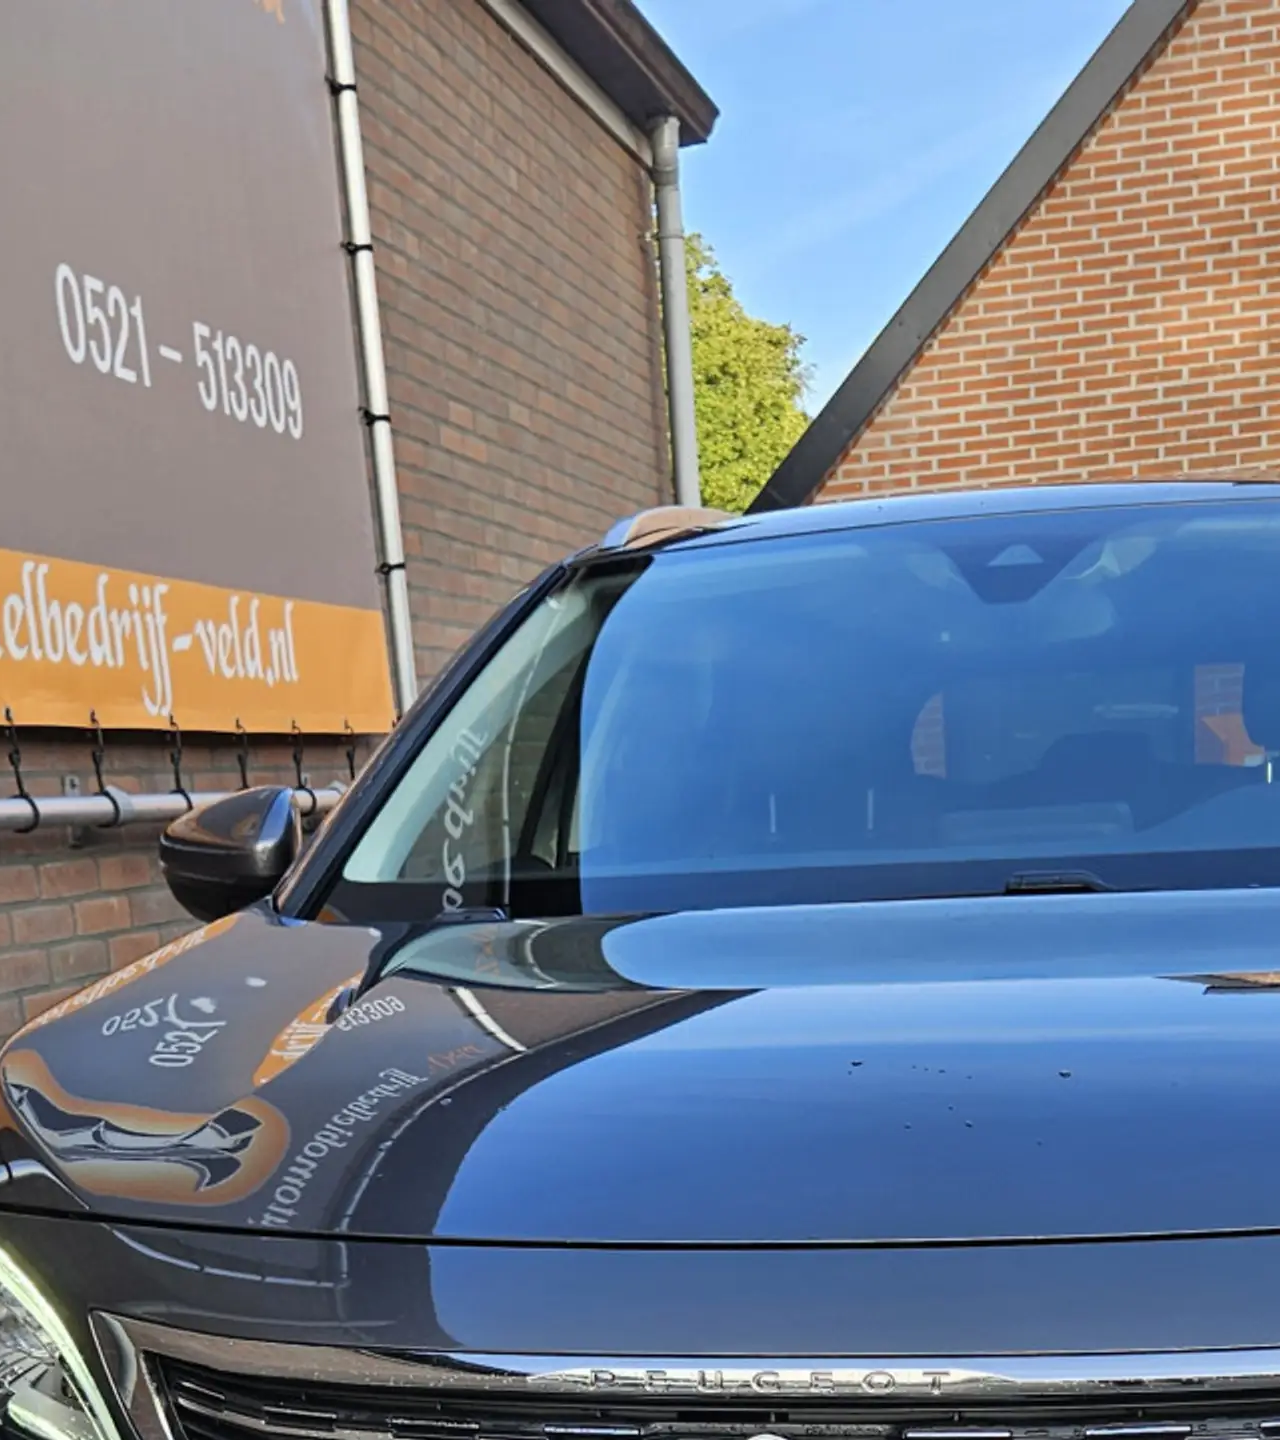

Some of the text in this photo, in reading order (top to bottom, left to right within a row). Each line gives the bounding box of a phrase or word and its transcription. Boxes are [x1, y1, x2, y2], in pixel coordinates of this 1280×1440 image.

[55, 262, 151, 388] 0521
[192, 320, 303, 440] 513309
[588, 1369, 952, 1397] PEUGEOT
